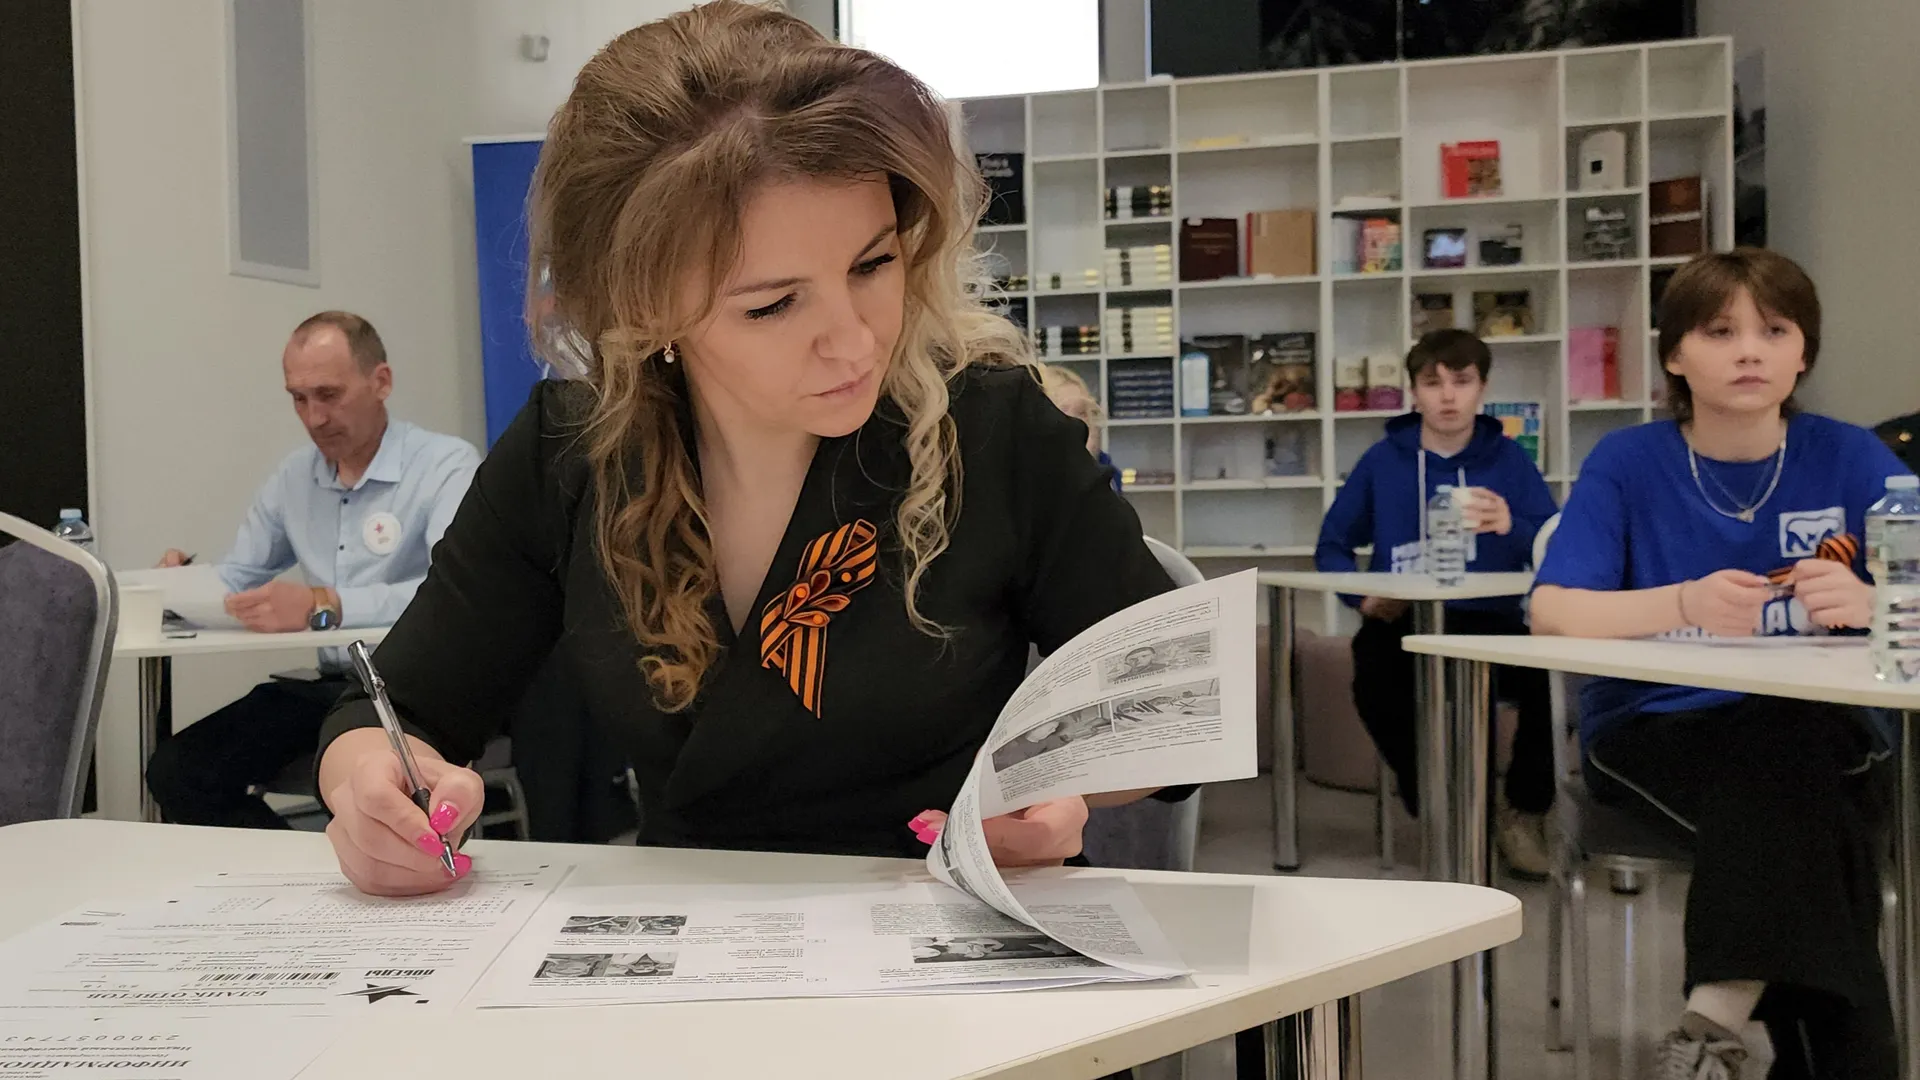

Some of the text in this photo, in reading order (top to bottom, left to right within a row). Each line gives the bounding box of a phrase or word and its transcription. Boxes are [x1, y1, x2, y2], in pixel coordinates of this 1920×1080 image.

[364, 969, 436, 977] ПОБЕДЫ
[86, 990, 268, 999] БЛАНК ОТВЕТОВ
